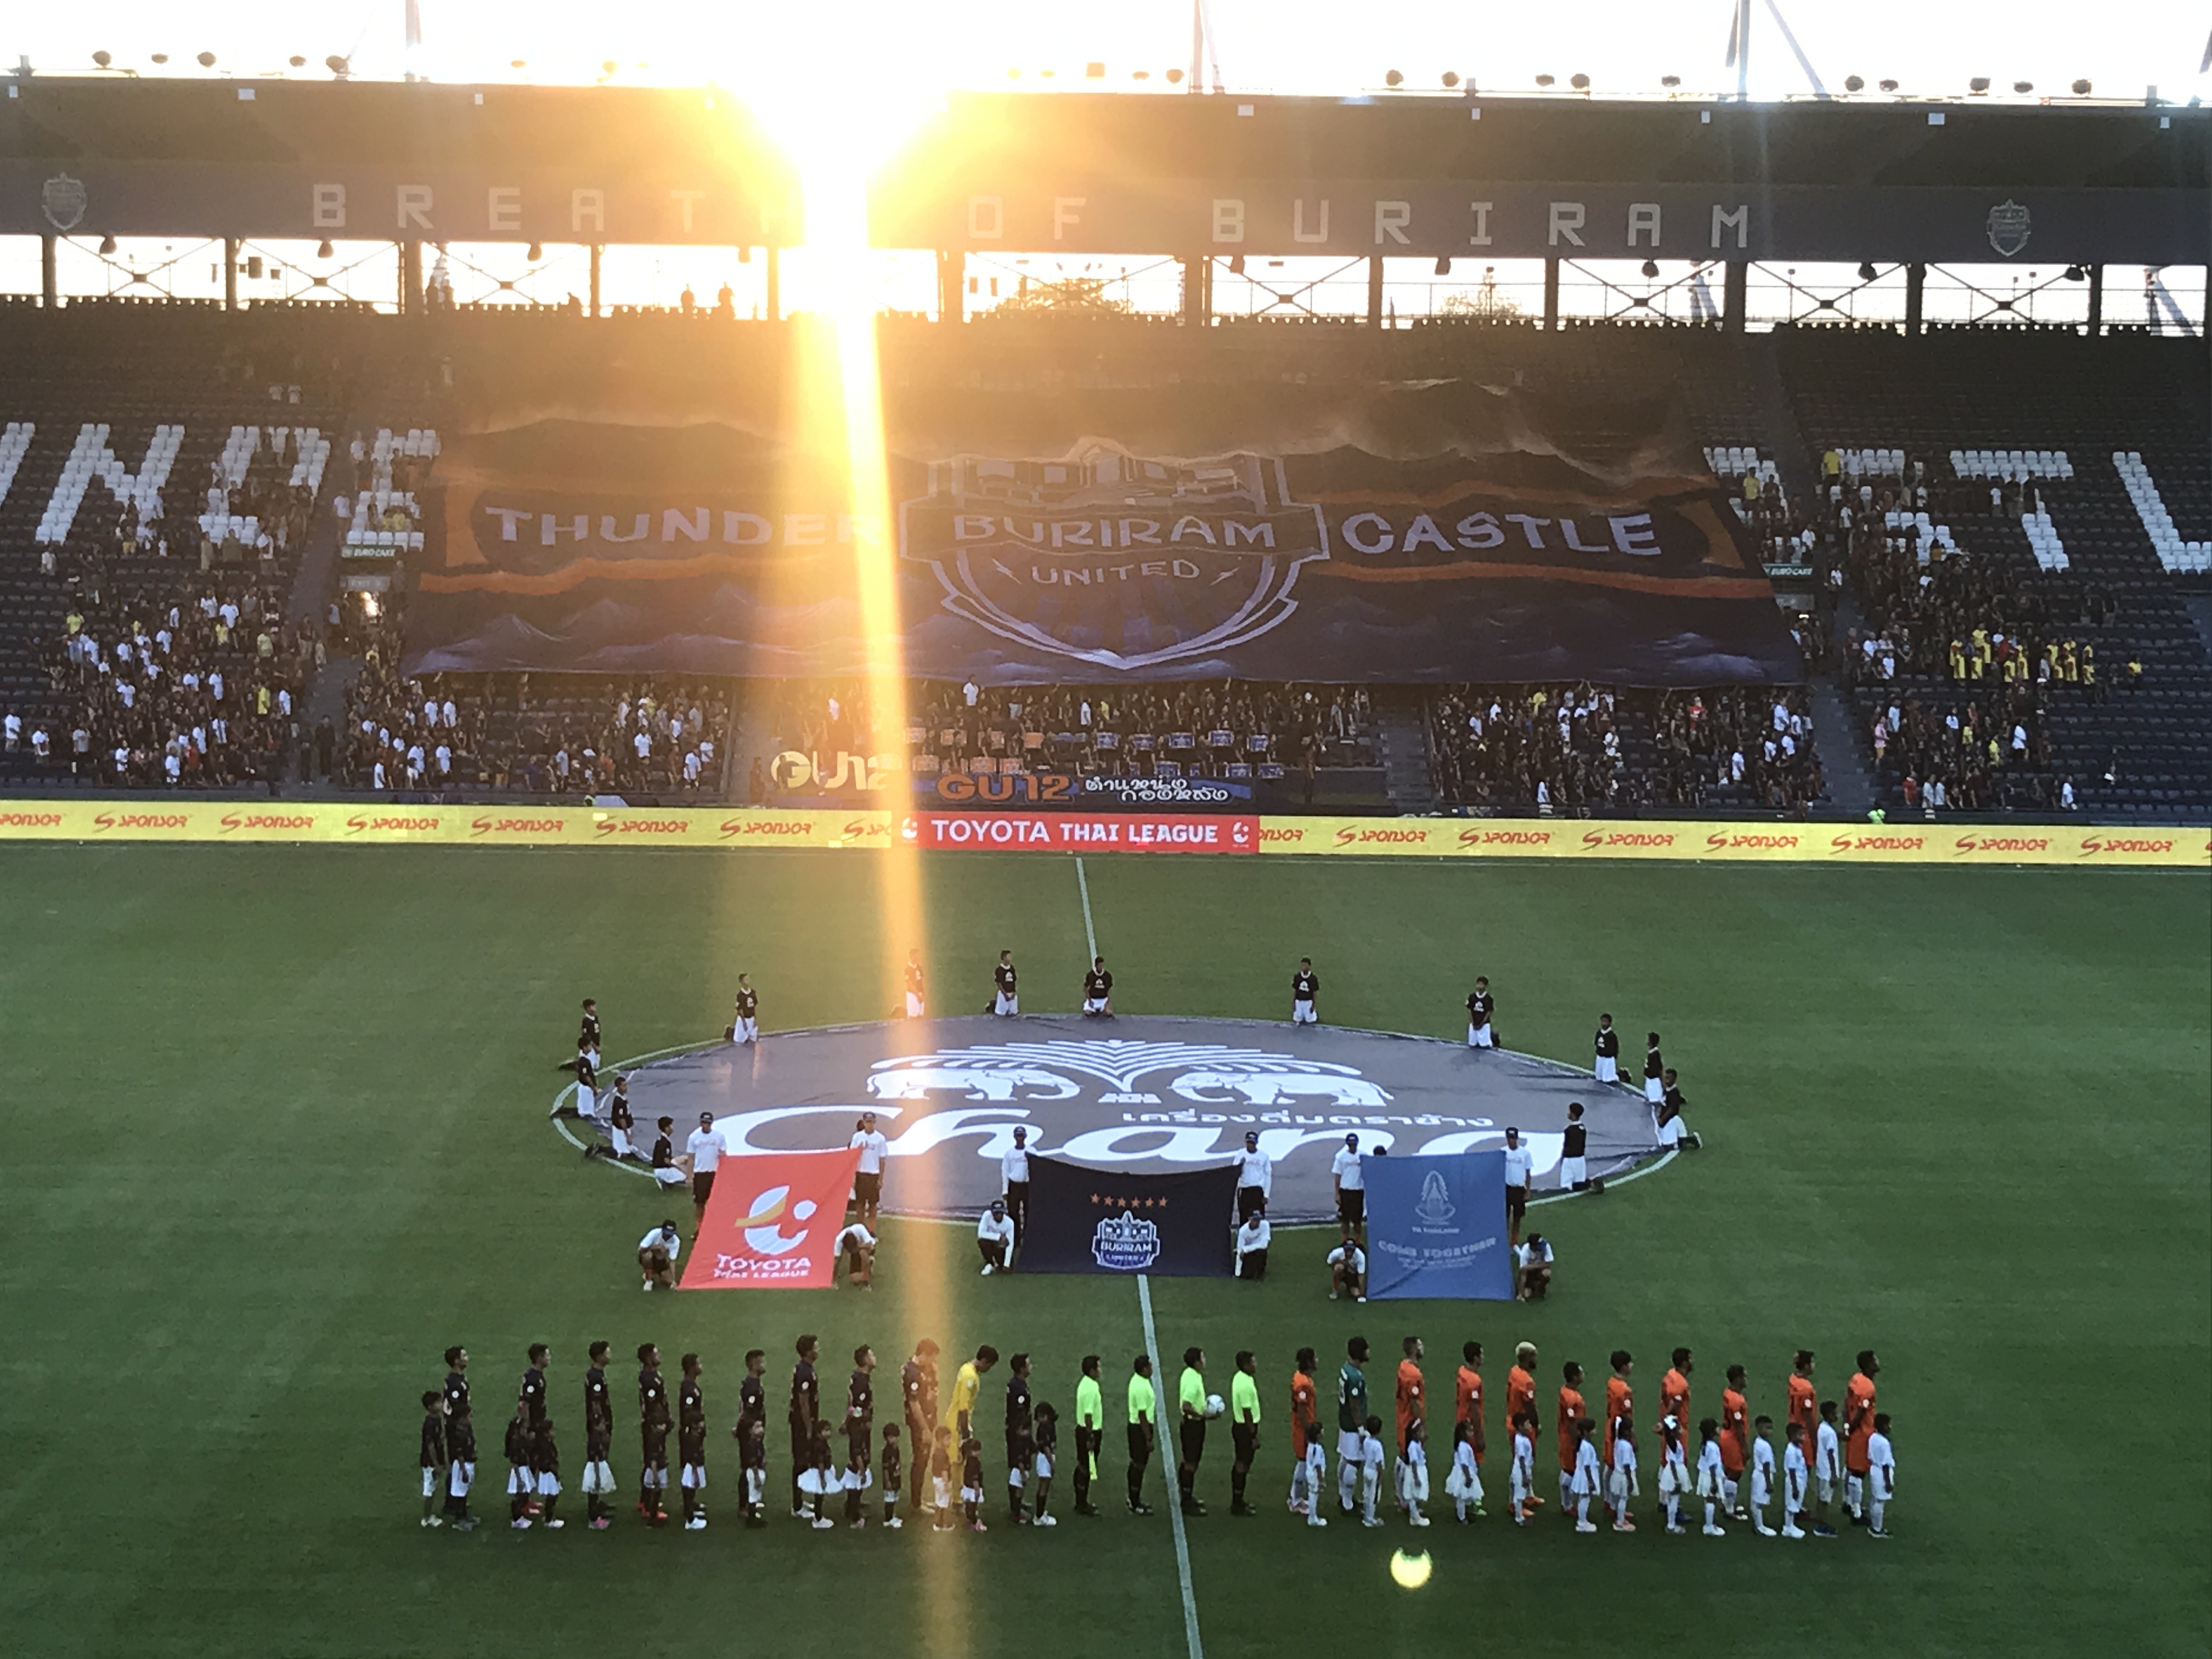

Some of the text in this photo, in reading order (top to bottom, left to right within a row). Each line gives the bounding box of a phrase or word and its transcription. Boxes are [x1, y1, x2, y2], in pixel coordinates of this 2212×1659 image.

[313, 183, 1748, 249] BREAT OF BURIRAM
[485, 506, 883, 546] THUNDER
[953, 514, 1276, 548] BURIRAM
[1340, 511, 1662, 556] CASTLE
[1031, 558, 1200, 586] UNITED
[936, 774, 1073, 801] GU12
[931, 819, 1218, 843] TOYOTA THAI LEAGUE
[1259, 828, 1304, 842] ONSOR
[1101, 1241, 1152, 1252] BURIRAM
[716, 1253, 812, 1271] TOYOTA
